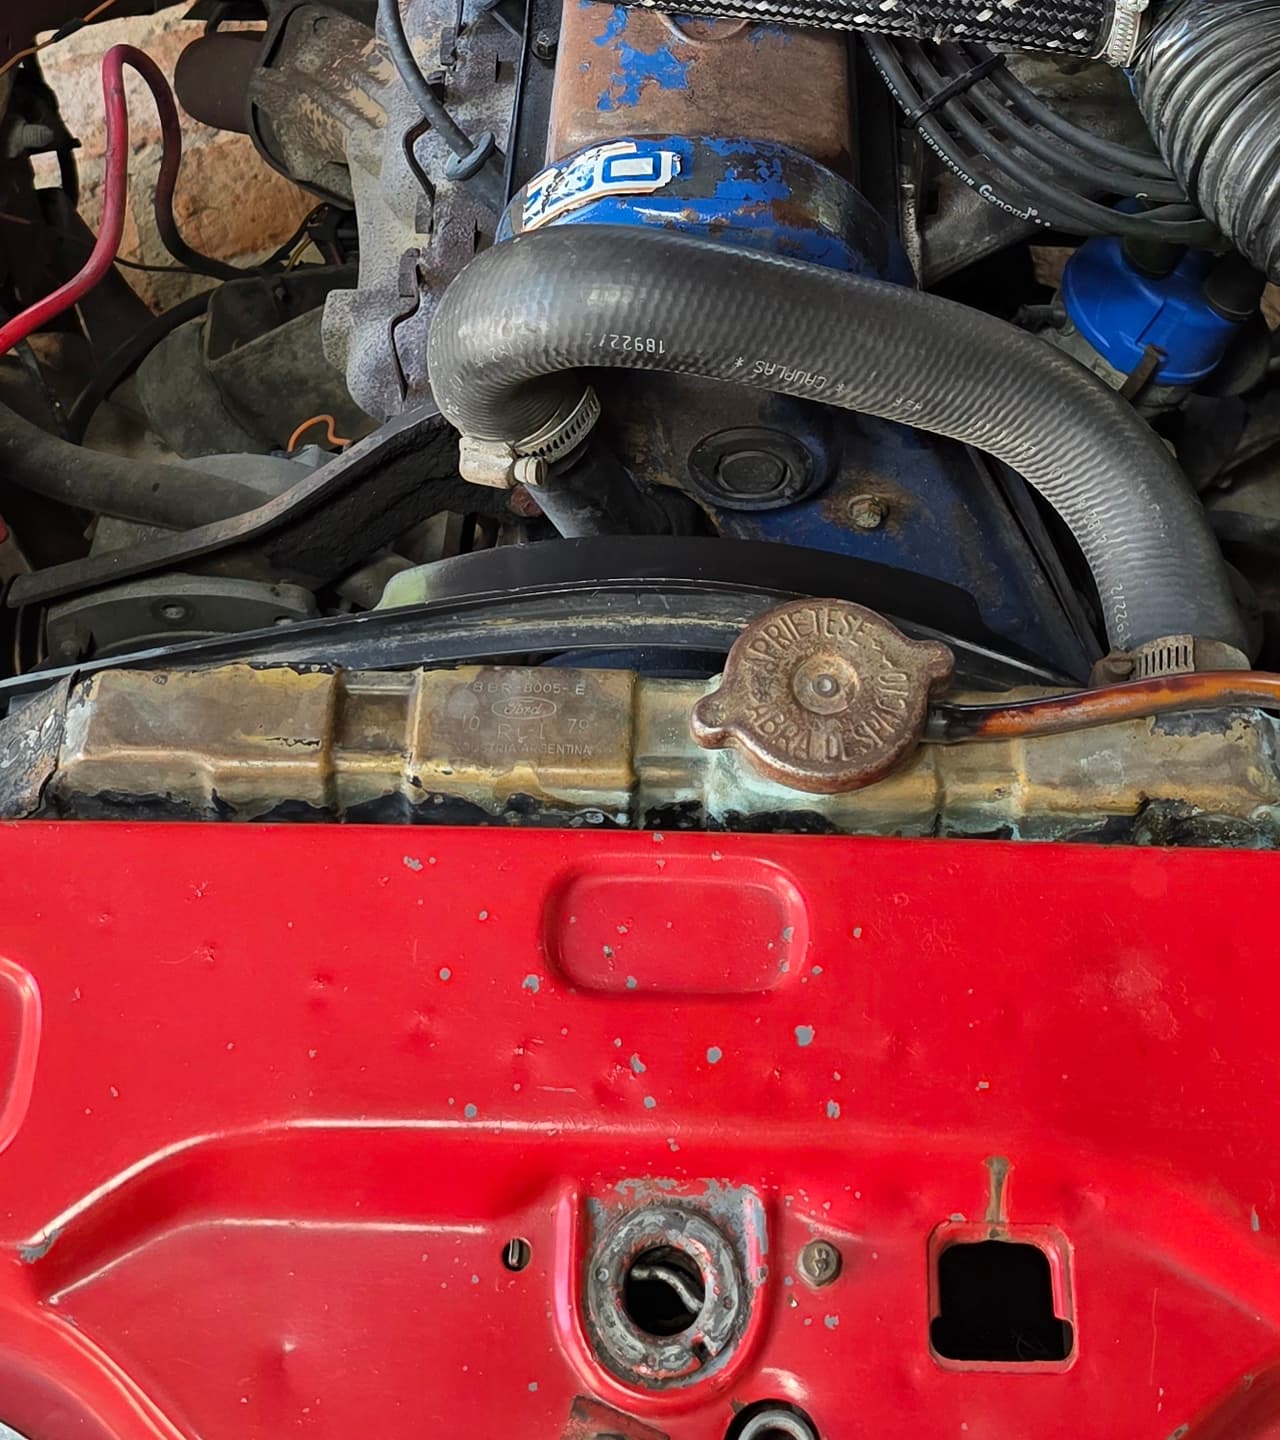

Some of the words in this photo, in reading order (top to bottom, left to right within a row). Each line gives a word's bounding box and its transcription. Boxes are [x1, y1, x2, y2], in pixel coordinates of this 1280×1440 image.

[918, 126, 976, 187] SUPPRESSION
[753, 360, 828, 390] CAUPLAS
[503, 699, 546, 715] Ford
